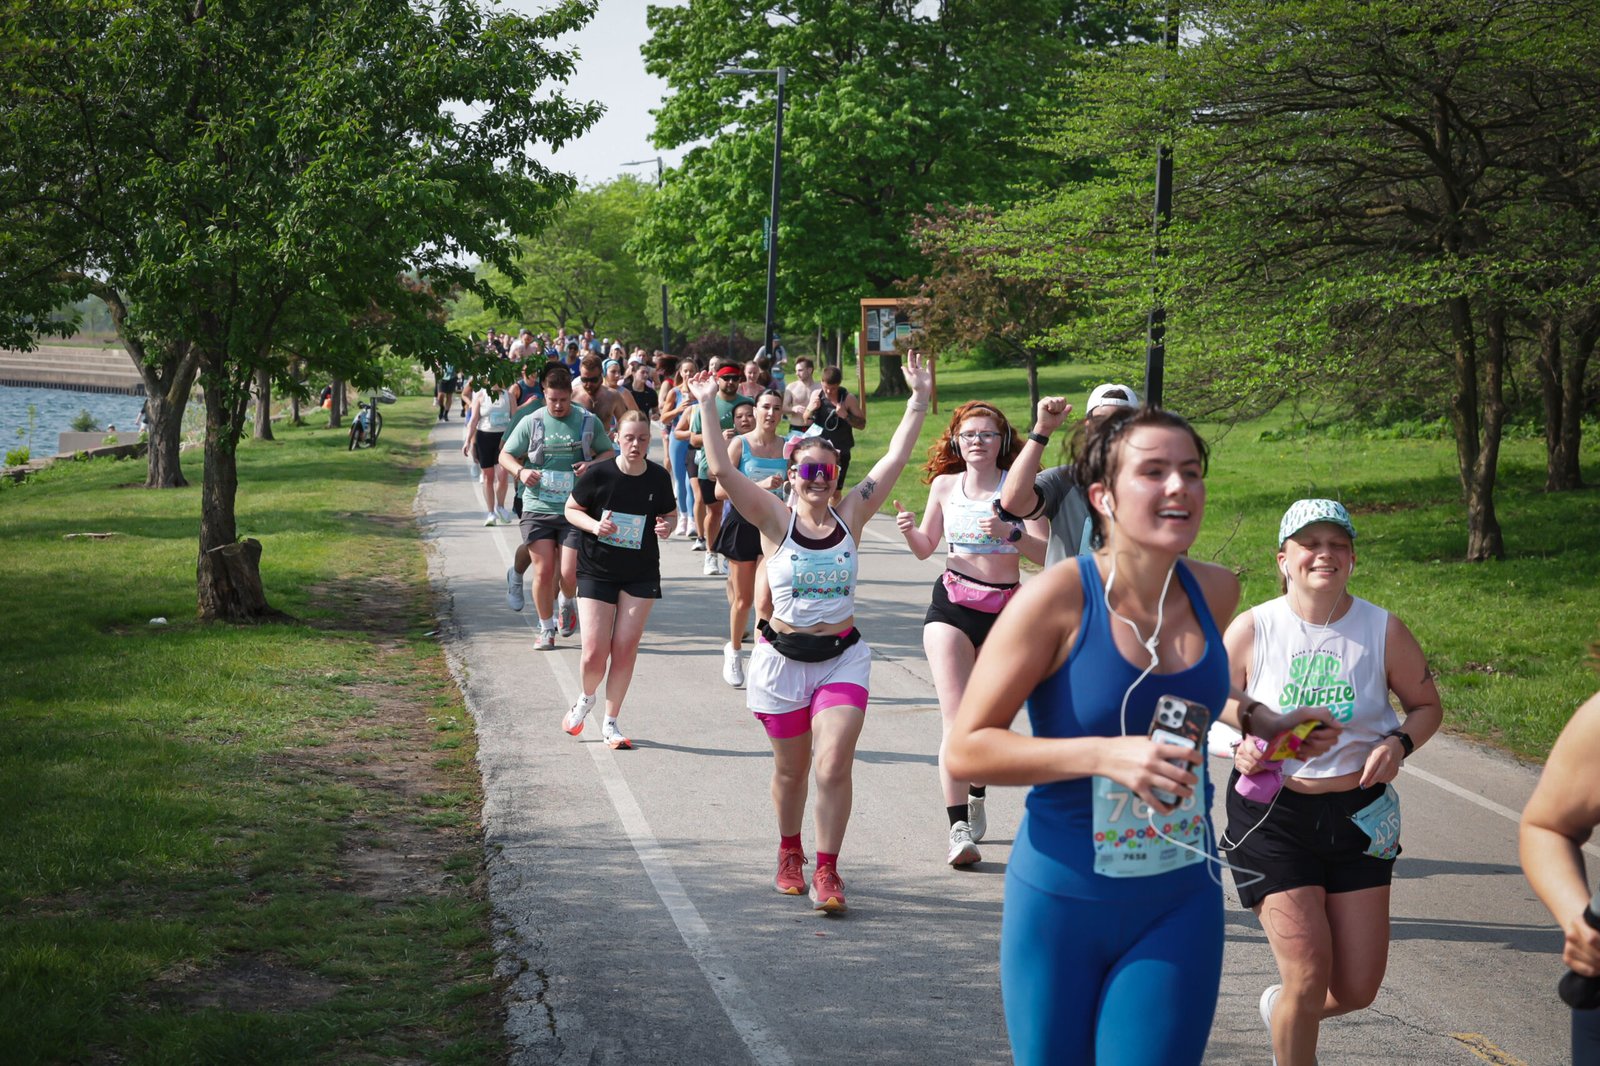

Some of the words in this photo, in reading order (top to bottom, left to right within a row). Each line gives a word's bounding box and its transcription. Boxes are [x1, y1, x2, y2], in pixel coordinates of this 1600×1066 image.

[796, 570, 849, 584] 10349
[1106, 785, 1197, 822] 768
[1375, 812, 1399, 845] 426
[1122, 853, 1147, 861] 7658
